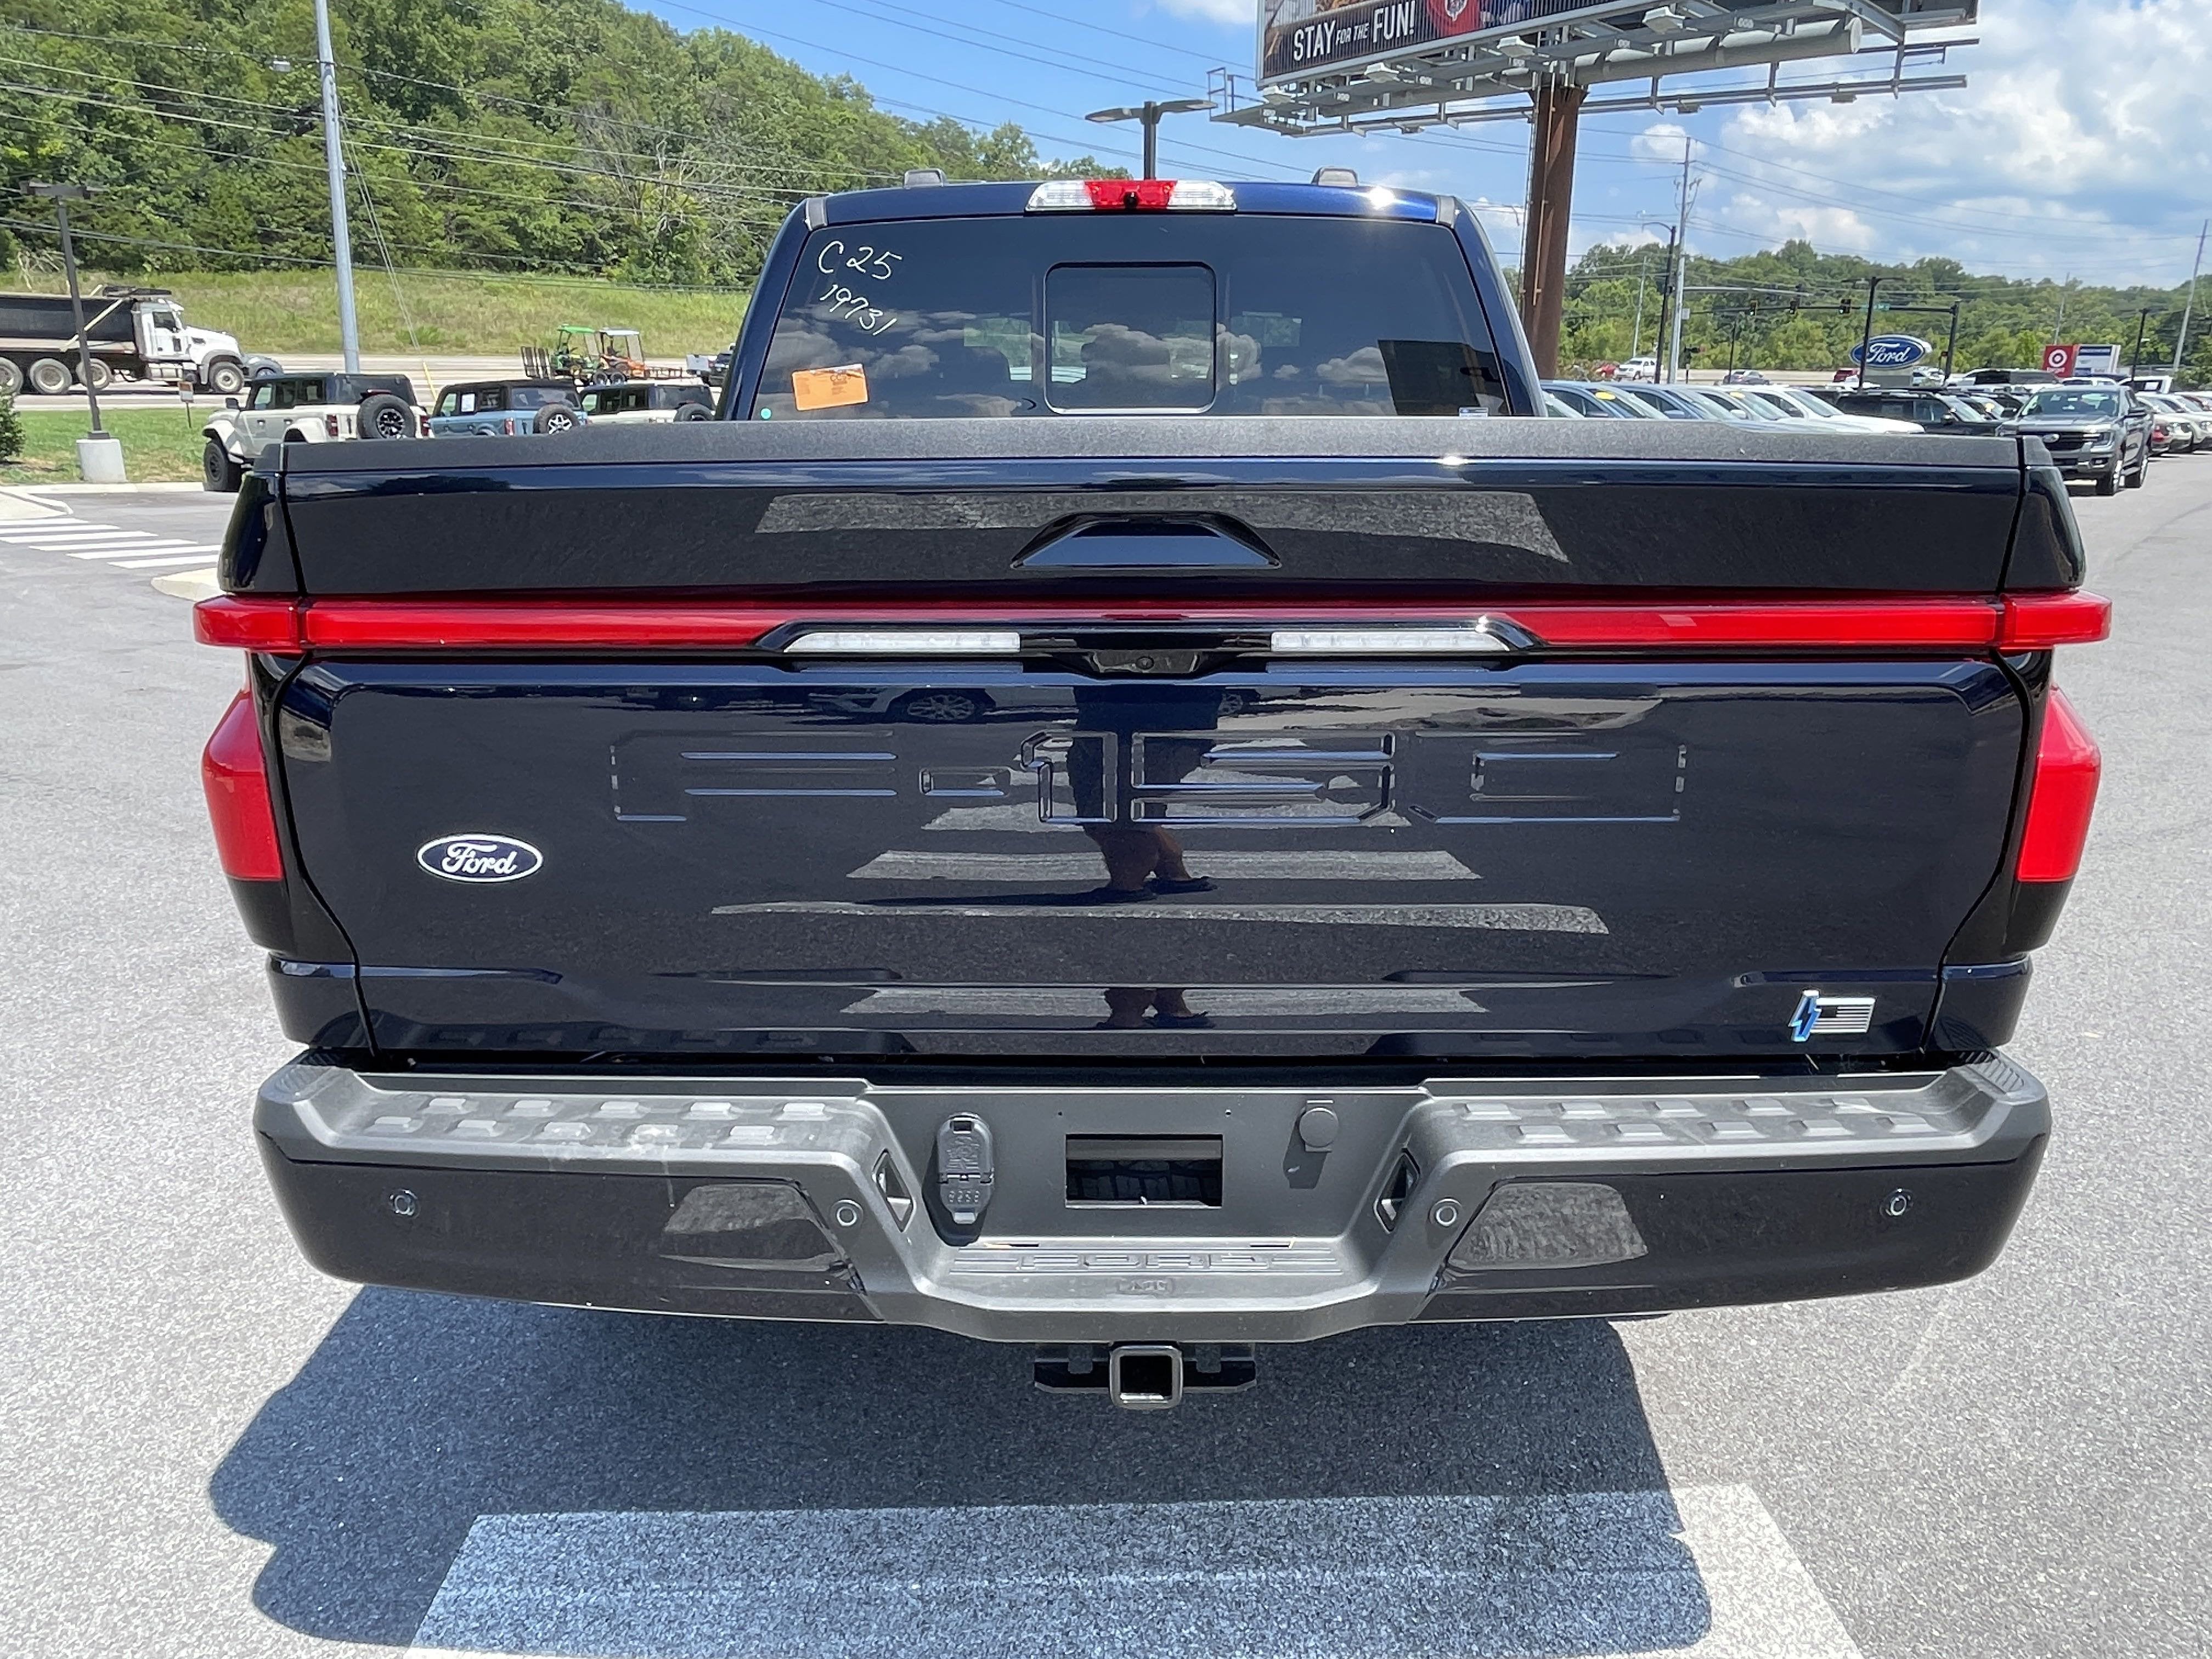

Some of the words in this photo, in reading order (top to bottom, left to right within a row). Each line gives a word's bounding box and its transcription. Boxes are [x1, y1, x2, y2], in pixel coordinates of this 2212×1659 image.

[1294, 19, 1336, 61] STAY
[1335, 27, 1352, 46] FOR
[1353, 22, 1369, 41] THE
[1373, 0, 1415, 43] FUN!
[1865, 342, 1912, 363] Ford
[441, 842, 518, 875] Ford
